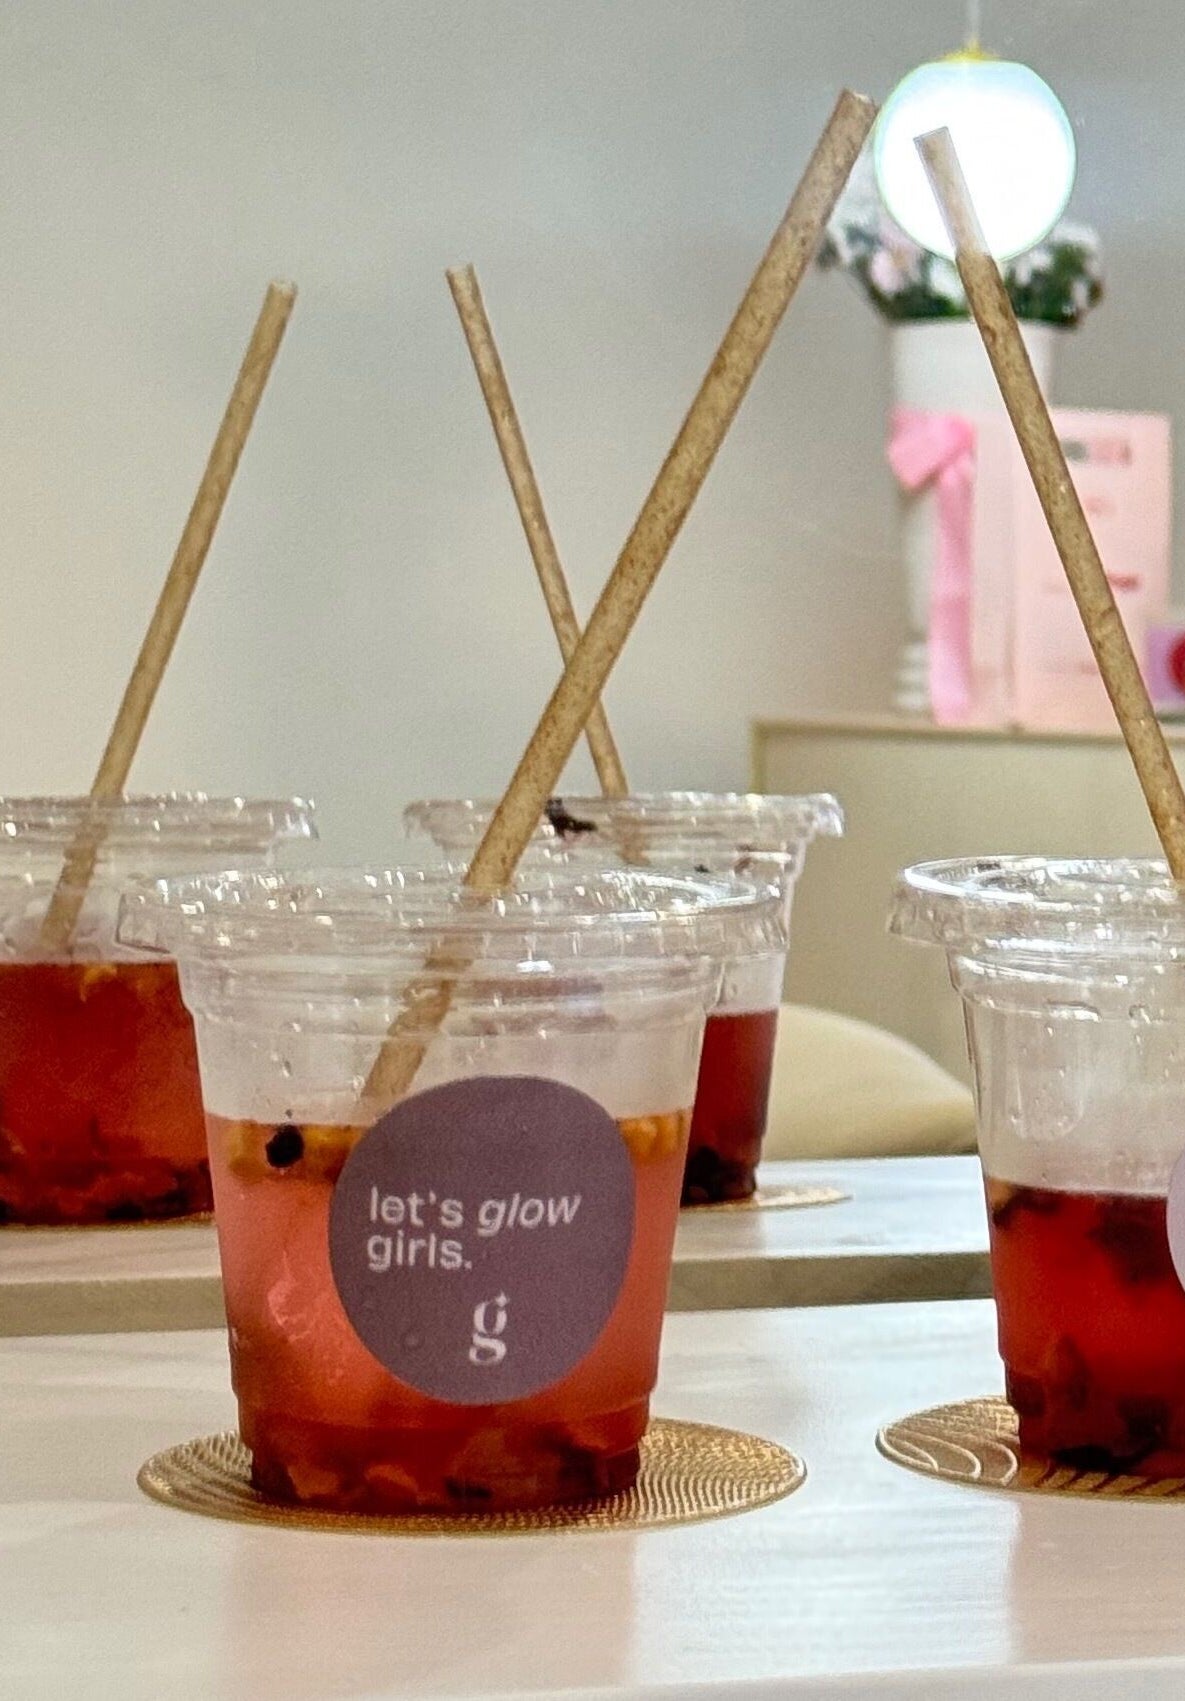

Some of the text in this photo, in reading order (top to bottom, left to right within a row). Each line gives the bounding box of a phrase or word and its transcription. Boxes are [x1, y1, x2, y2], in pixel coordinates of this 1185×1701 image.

[369, 1186, 583, 1237] let's glow
[366, 1231, 472, 1271] girls.
[468, 1292, 508, 1364] g
